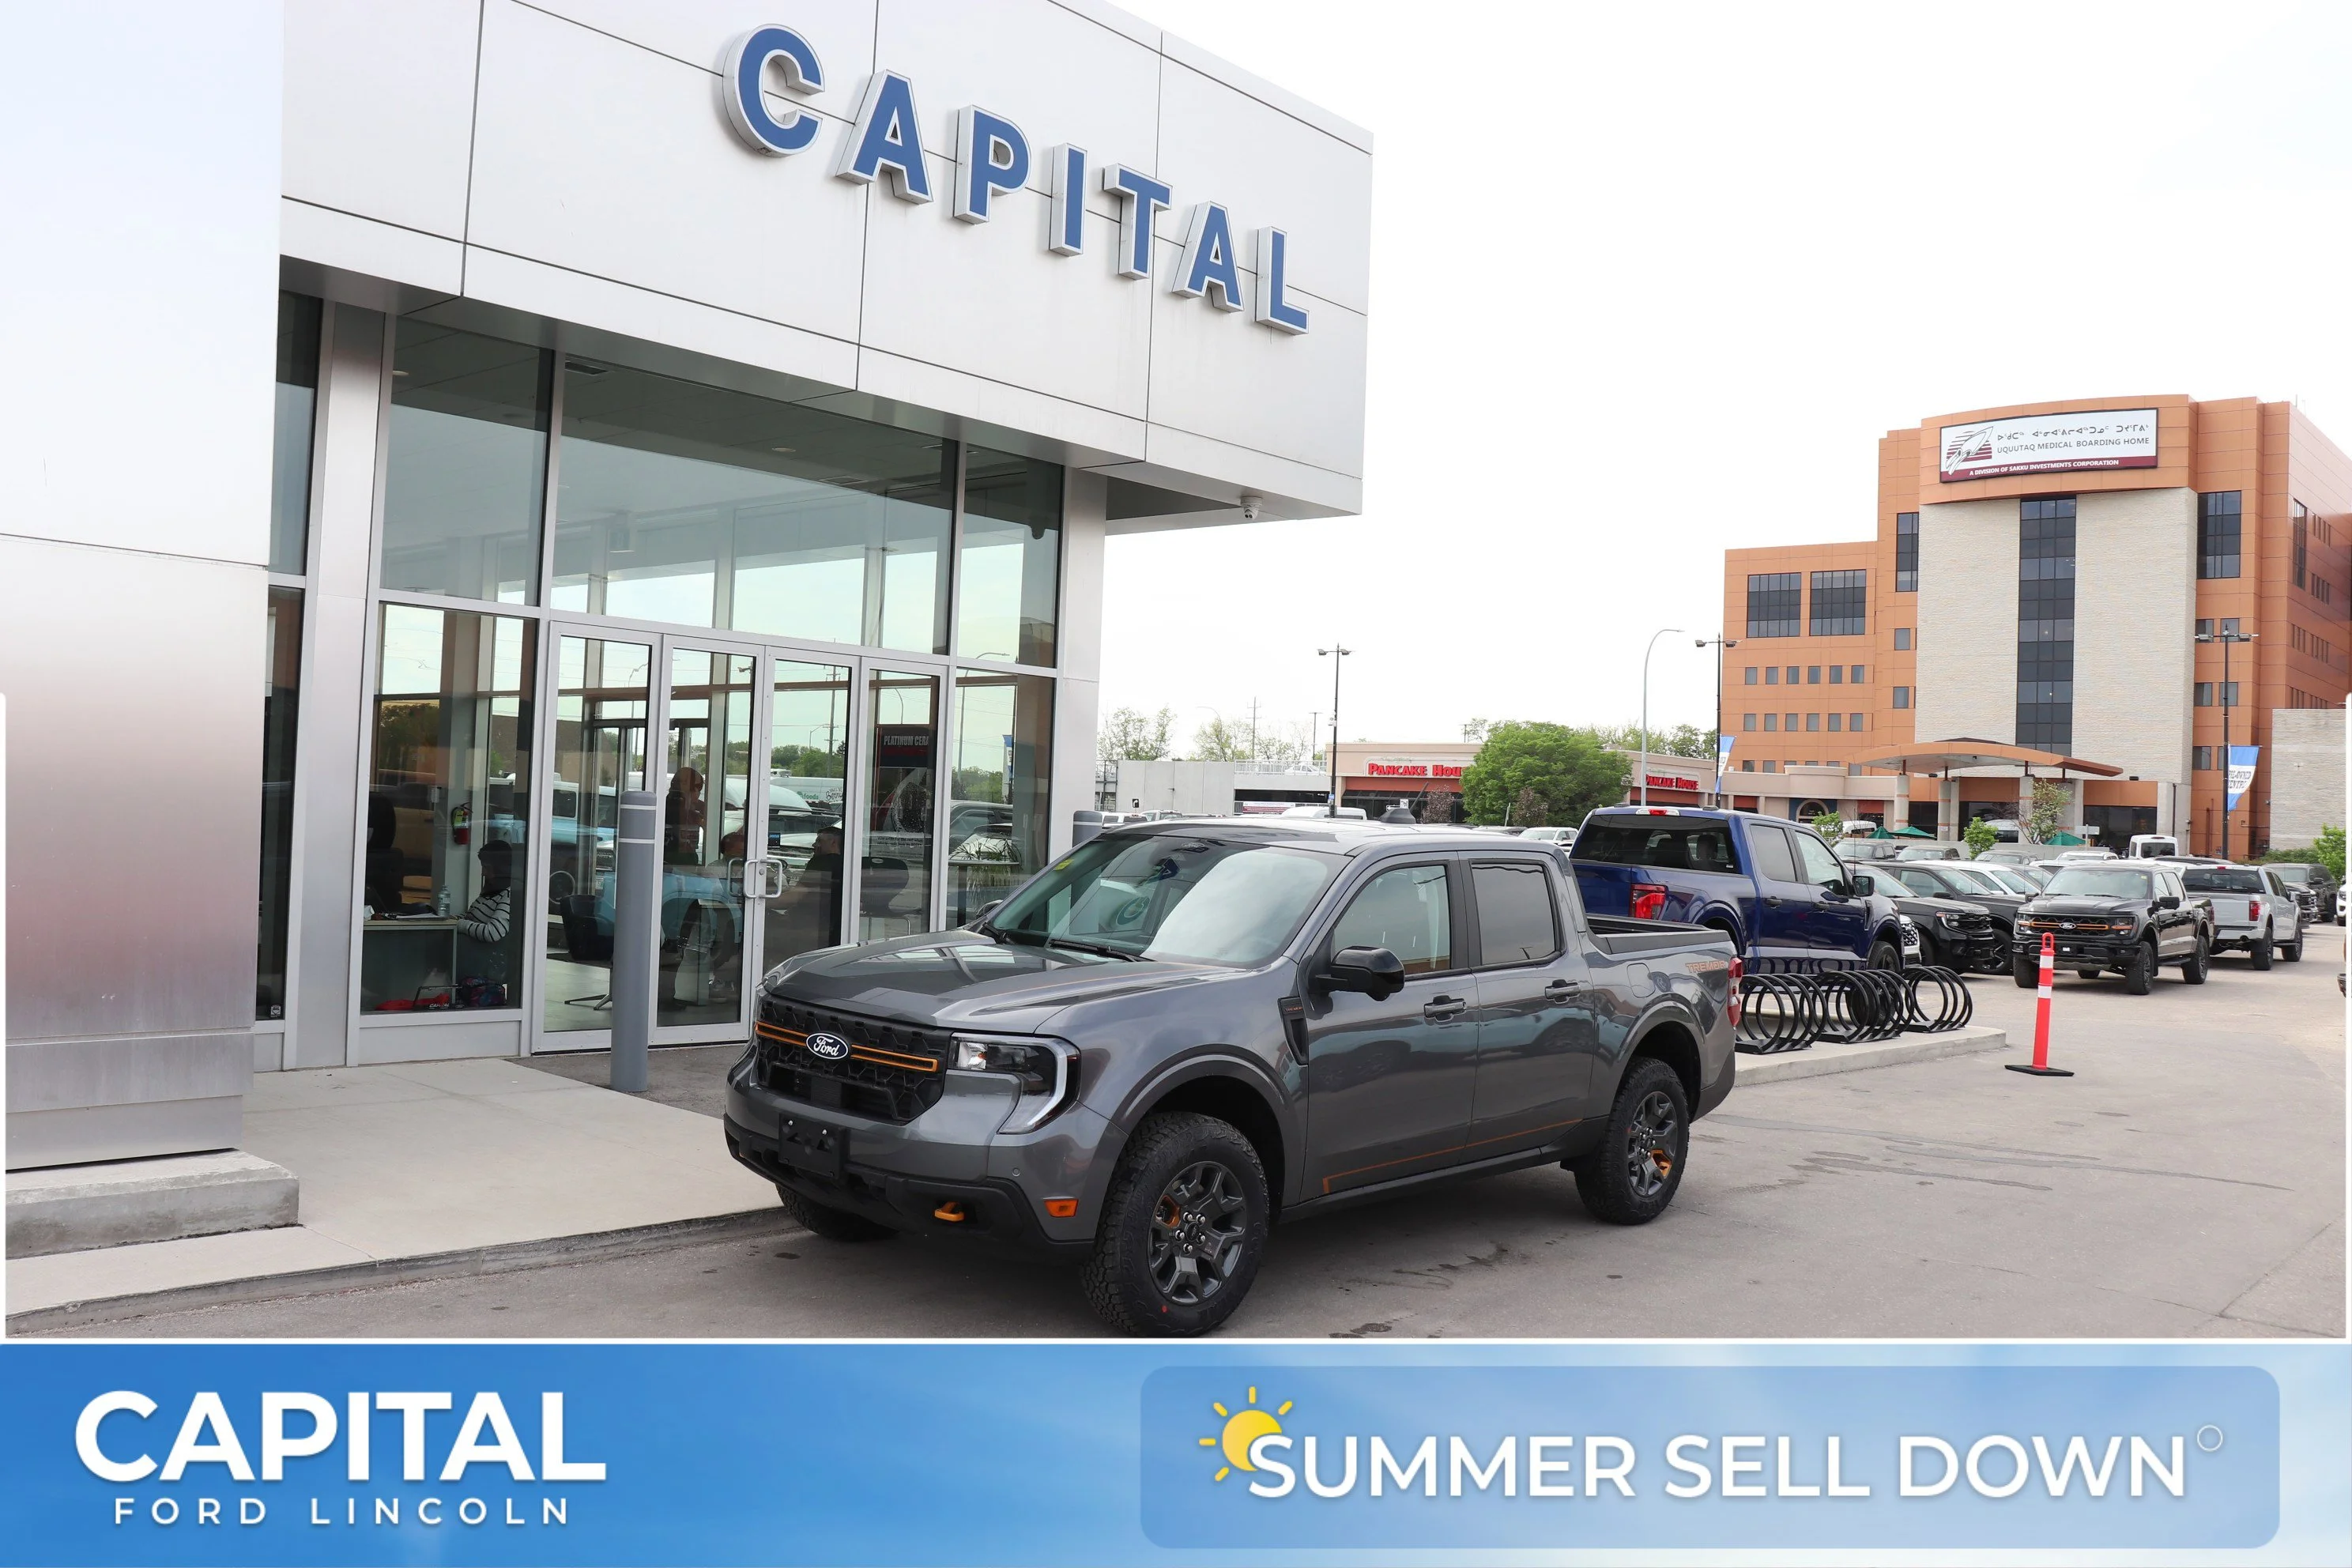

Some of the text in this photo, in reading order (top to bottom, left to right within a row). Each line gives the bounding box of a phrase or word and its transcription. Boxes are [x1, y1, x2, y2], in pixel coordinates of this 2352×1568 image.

[722, 23, 1310, 335] CAPITAL
[1997, 443, 2036, 454] UQUUTAQ
[2037, 441, 2073, 450] MEDICAL
[2076, 438, 2120, 447] BOARDING
[2030, 462, 2072, 470] INVESTMENTS
[2073, 459, 2120, 468] CORPORATION
[884, 736, 914, 745] PLATINUM
[1368, 763, 1464, 777] PANCAKE HOU
[1645, 773, 1699, 790] PANCAKE HOUSE
[1685, 959, 1726, 973] TREMOR
[813, 1035, 840, 1057] Ford
